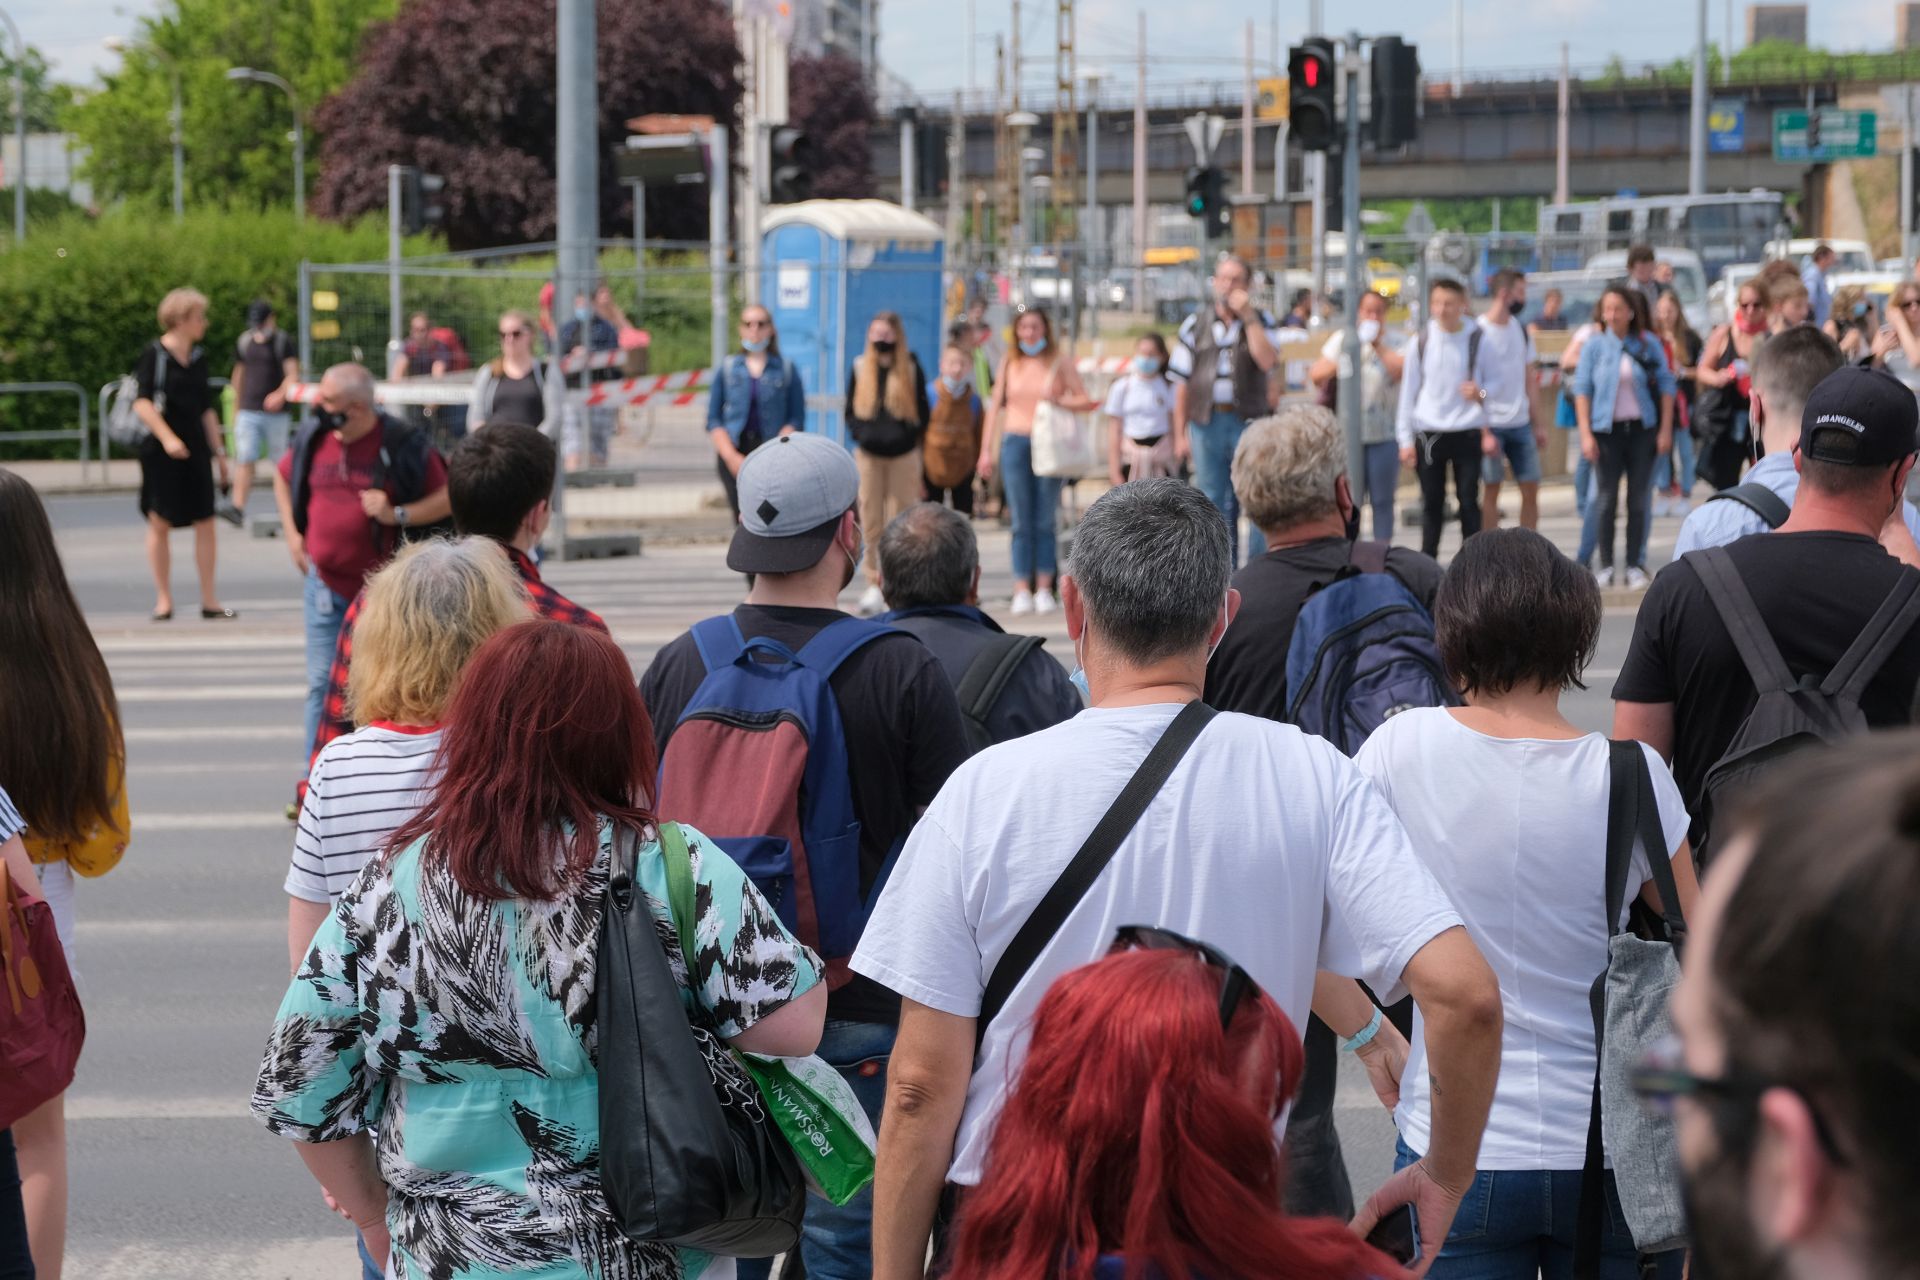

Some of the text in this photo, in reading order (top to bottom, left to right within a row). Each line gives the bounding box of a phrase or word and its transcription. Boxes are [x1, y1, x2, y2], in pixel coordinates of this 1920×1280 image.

[1816, 414, 1866, 433] LOS ANGELES
[769, 1078, 834, 1157] ROSSMANN
